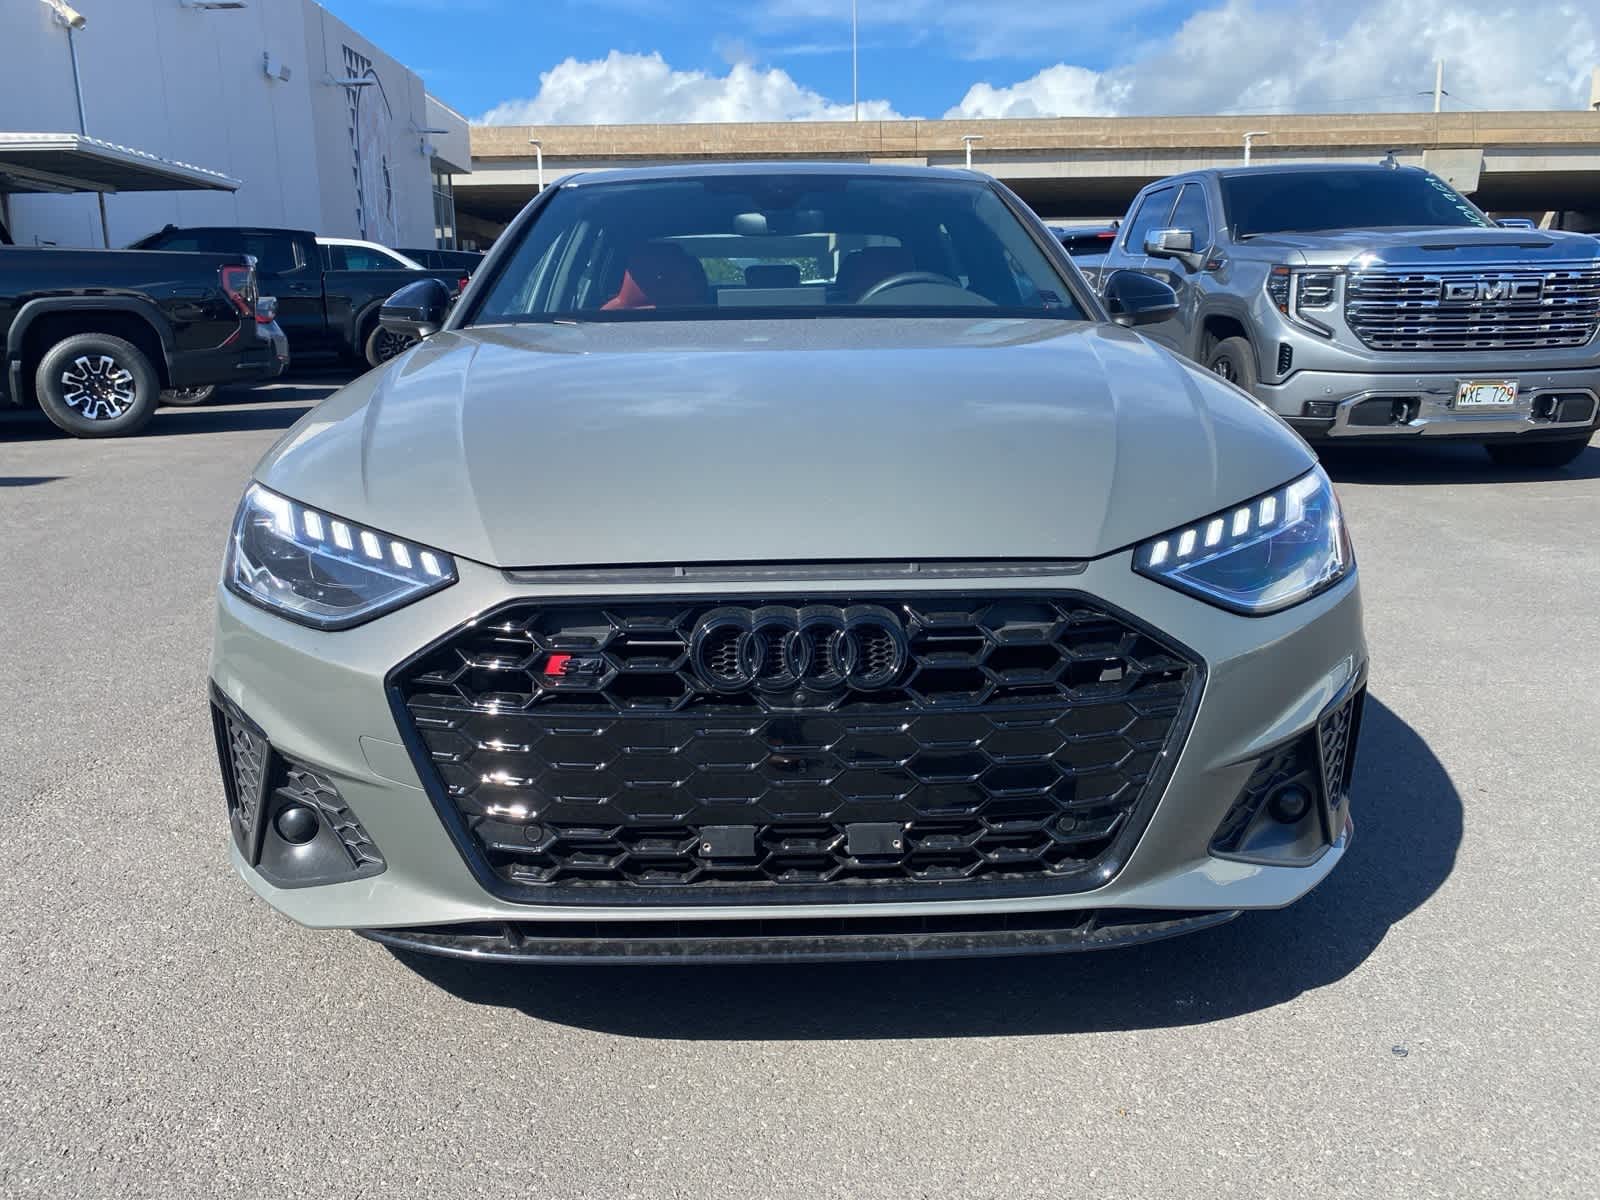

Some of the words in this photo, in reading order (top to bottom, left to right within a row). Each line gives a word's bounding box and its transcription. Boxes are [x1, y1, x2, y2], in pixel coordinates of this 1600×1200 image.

[1445, 281, 1540, 300] GMC
[1460, 387, 1484, 402] WXE
[1493, 387, 1514, 402] 729
